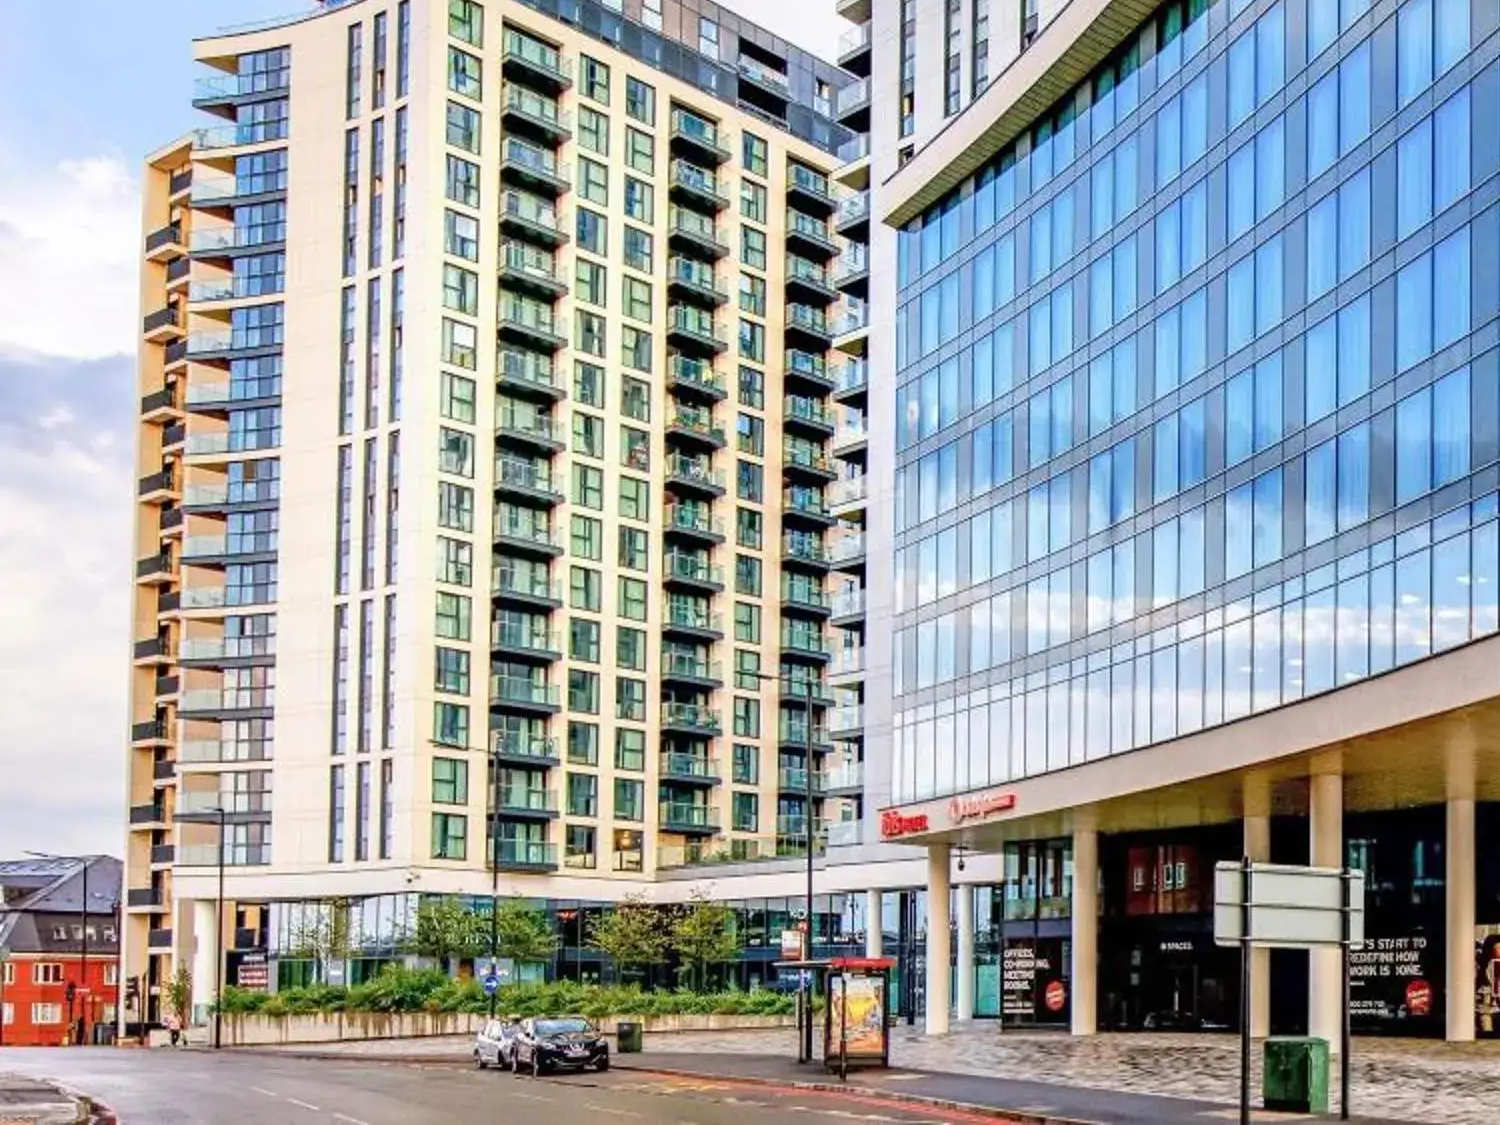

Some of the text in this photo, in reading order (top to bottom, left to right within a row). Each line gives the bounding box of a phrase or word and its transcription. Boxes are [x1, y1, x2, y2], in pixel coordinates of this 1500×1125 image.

[1377, 938, 1409, 950] START
[1412, 937, 1427, 949] TO
[1395, 951, 1420, 962] HOW
[1350, 965, 1377, 976] WORK
[1379, 965, 1391, 976] IS
